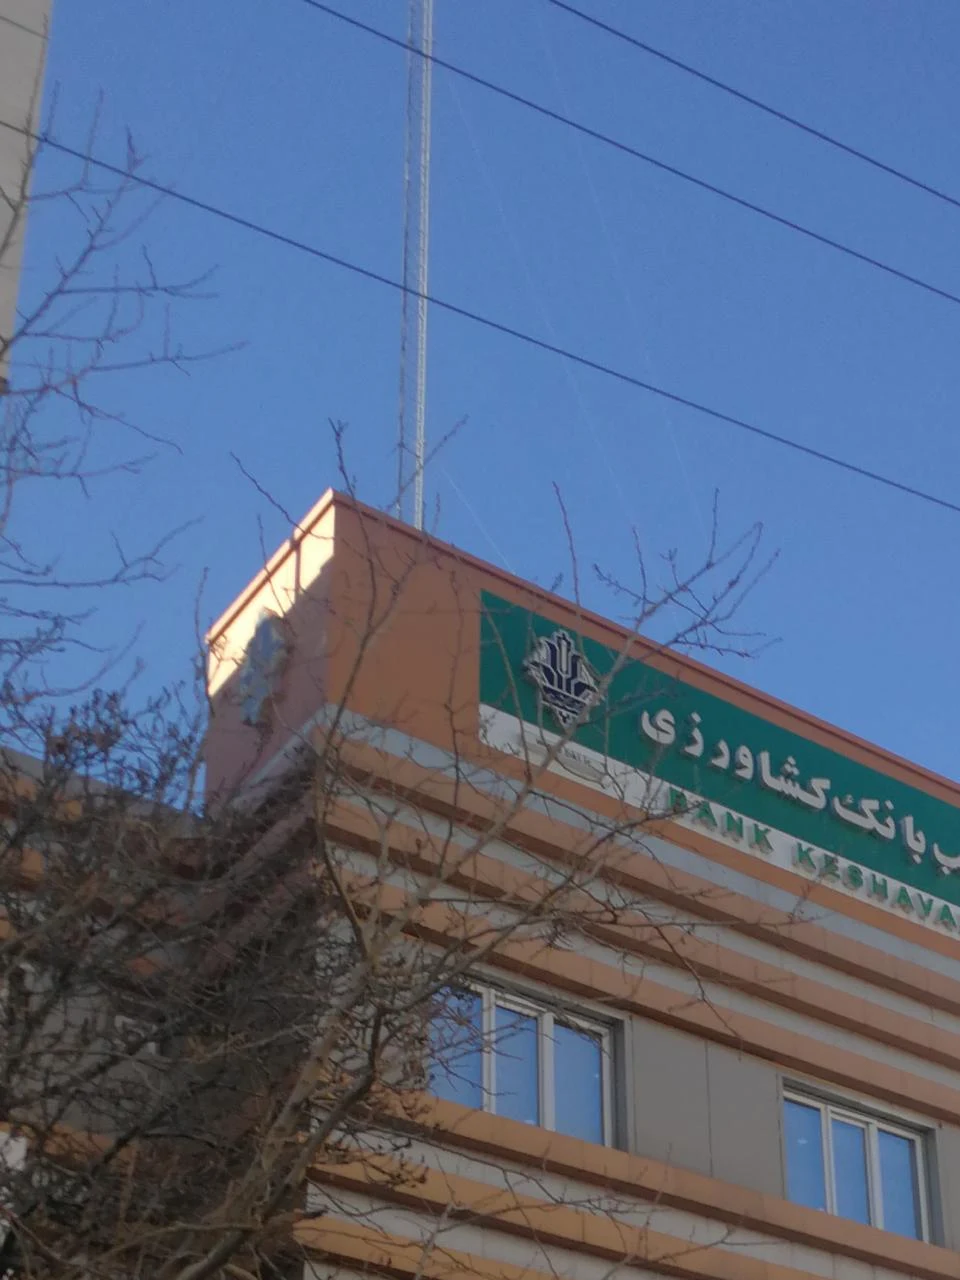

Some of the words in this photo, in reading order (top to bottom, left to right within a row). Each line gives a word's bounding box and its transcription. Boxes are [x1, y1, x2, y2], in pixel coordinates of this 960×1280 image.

[641, 708, 831, 811] کشاورزی
[667, 785, 774, 855] BANK
[833, 793, 926, 864] بانک
